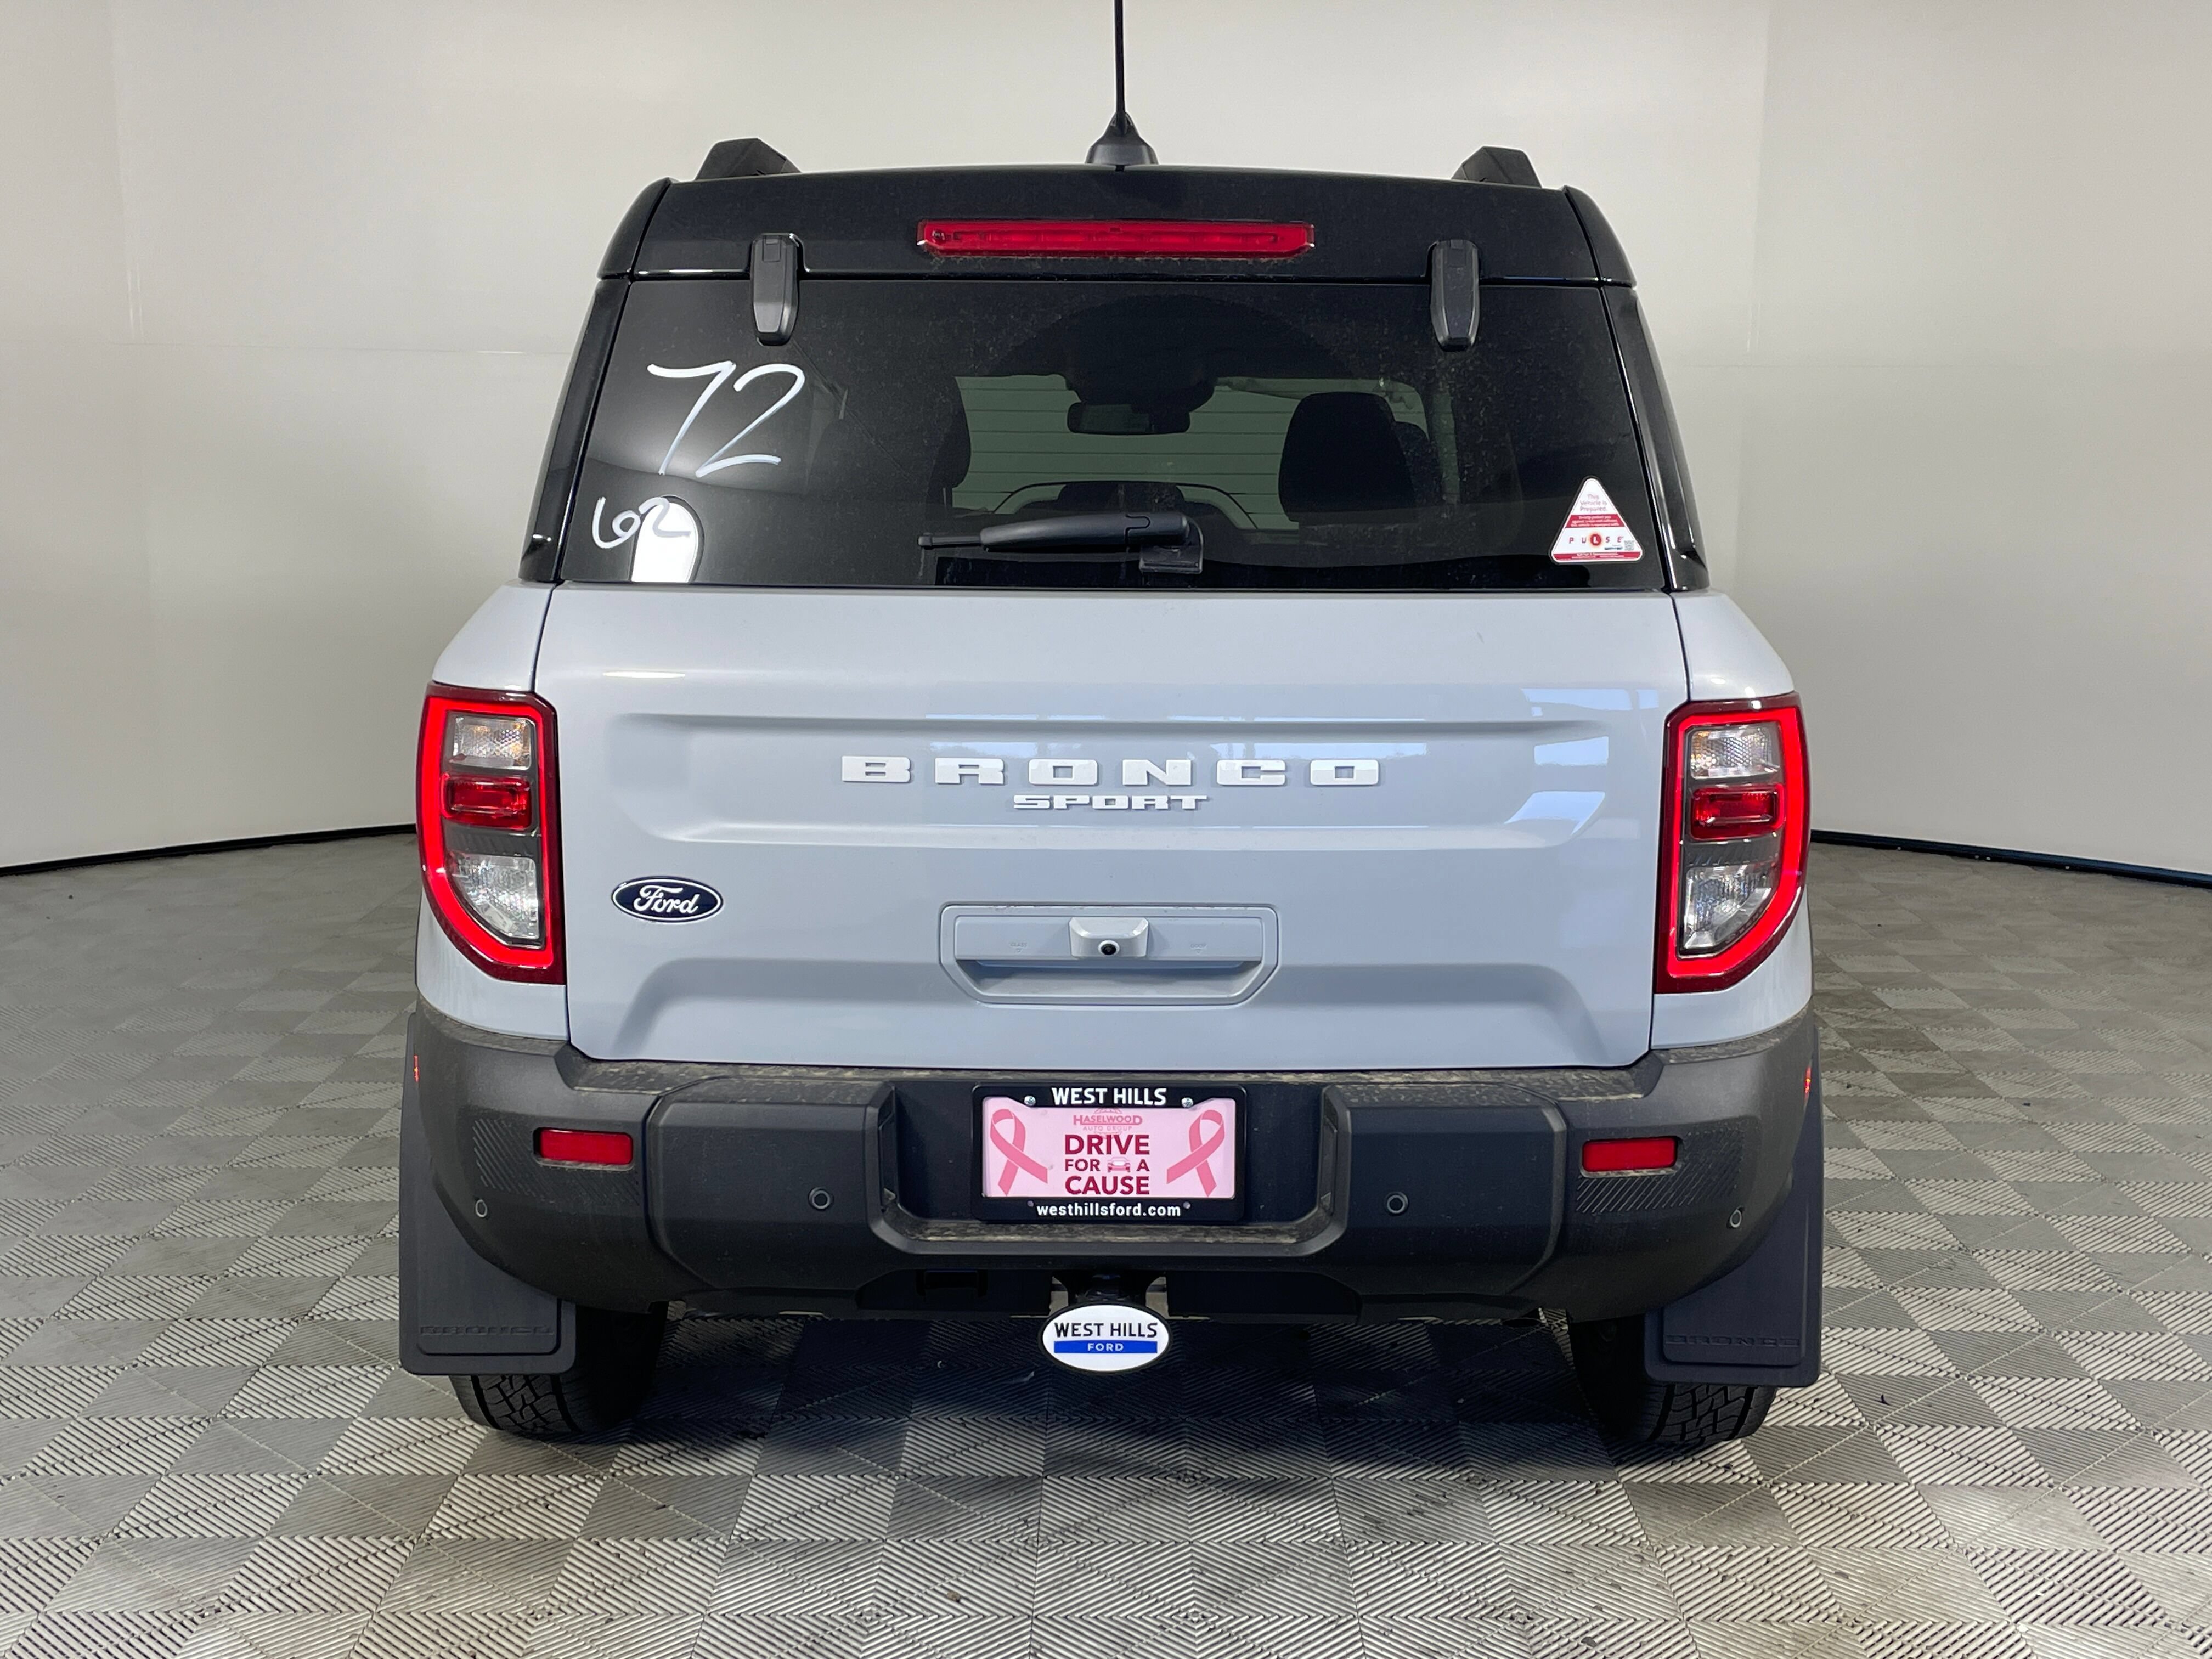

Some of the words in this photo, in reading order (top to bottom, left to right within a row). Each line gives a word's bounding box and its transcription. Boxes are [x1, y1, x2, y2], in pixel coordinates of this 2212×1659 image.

[647, 360, 805, 478] 72
[591, 496, 692, 549] 62
[842, 755, 1379, 786] BRONCO
[1013, 794, 1208, 810] SPORT
[633, 884, 701, 914] Ford
[1051, 1087, 1108, 1105] WEST
[1113, 1088, 1167, 1106] HILLS
[1073, 1114, 1143, 1126] HASELWOOD
[1064, 1134, 1150, 1155] DRIVE
[1064, 1158, 1101, 1172] FOR
[1136, 1158, 1150, 1172] A
[1064, 1175, 1150, 1195] CAUSE
[1036, 1202, 1181, 1216] westhillsford.com
[1054, 1322, 1104, 1338] WEST
[1110, 1322, 1158, 1338] HILLS
[1087, 1342, 1124, 1352] FORD
[1664, 1334, 1800, 1347] BRONCO
